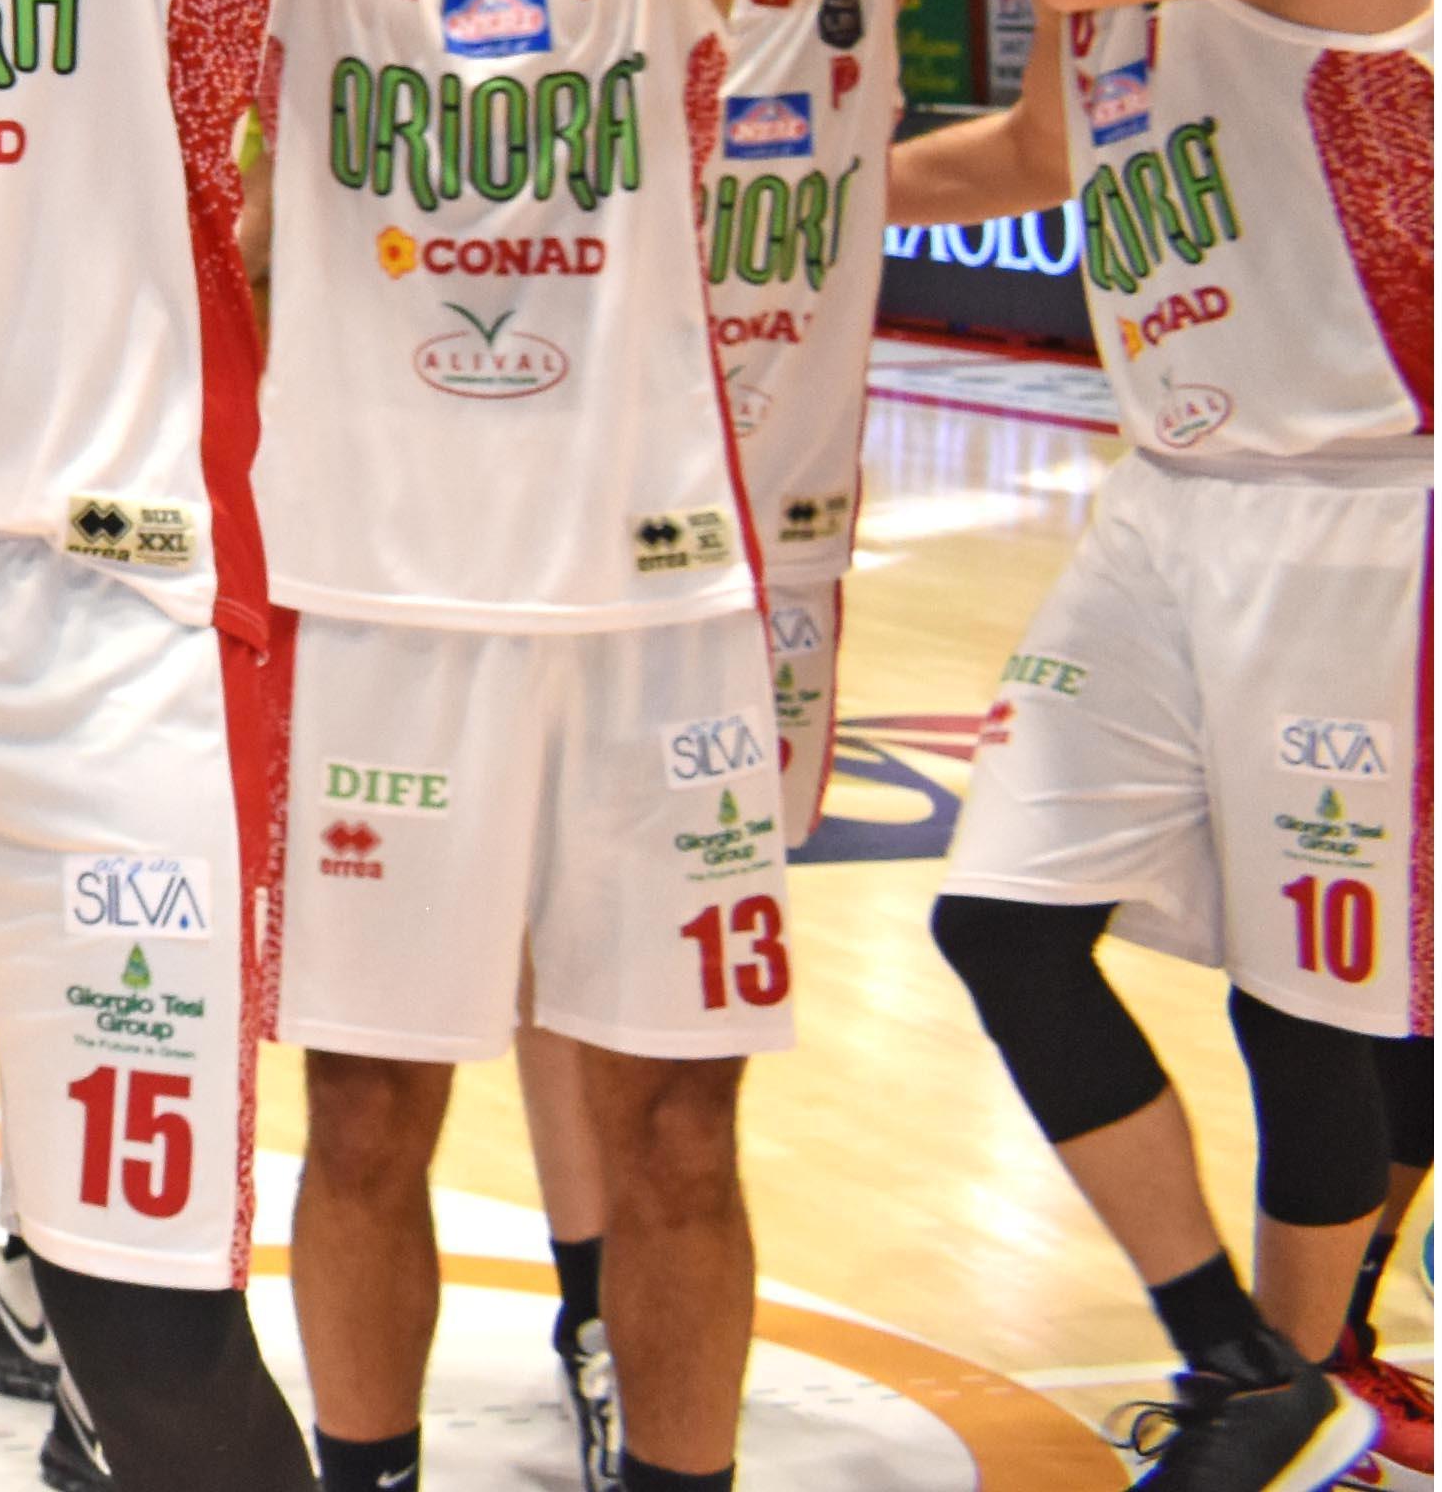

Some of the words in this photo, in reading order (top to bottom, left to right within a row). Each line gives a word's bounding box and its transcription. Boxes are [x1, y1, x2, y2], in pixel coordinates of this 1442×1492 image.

[329, 56, 644, 211] ORIORA
[420, 236, 606, 278] CONAD
[426, 351, 556, 373] ALIVAL
[137, 532, 189, 552] XXL
[673, 724, 765, 780] SILVA
[1279, 725, 1388, 774] SILVA
[325, 762, 448, 810] DIFE
[319, 858, 384, 881] errea
[74, 871, 206, 929] SILVA
[680, 894, 792, 1010] 13
[1280, 873, 1378, 984] 10
[66, 984, 155, 1016] Giorgio
[160, 993, 205, 1017] Tesi
[96, 1010, 174, 1042] Group
[66, 1064, 195, 1221] 15
